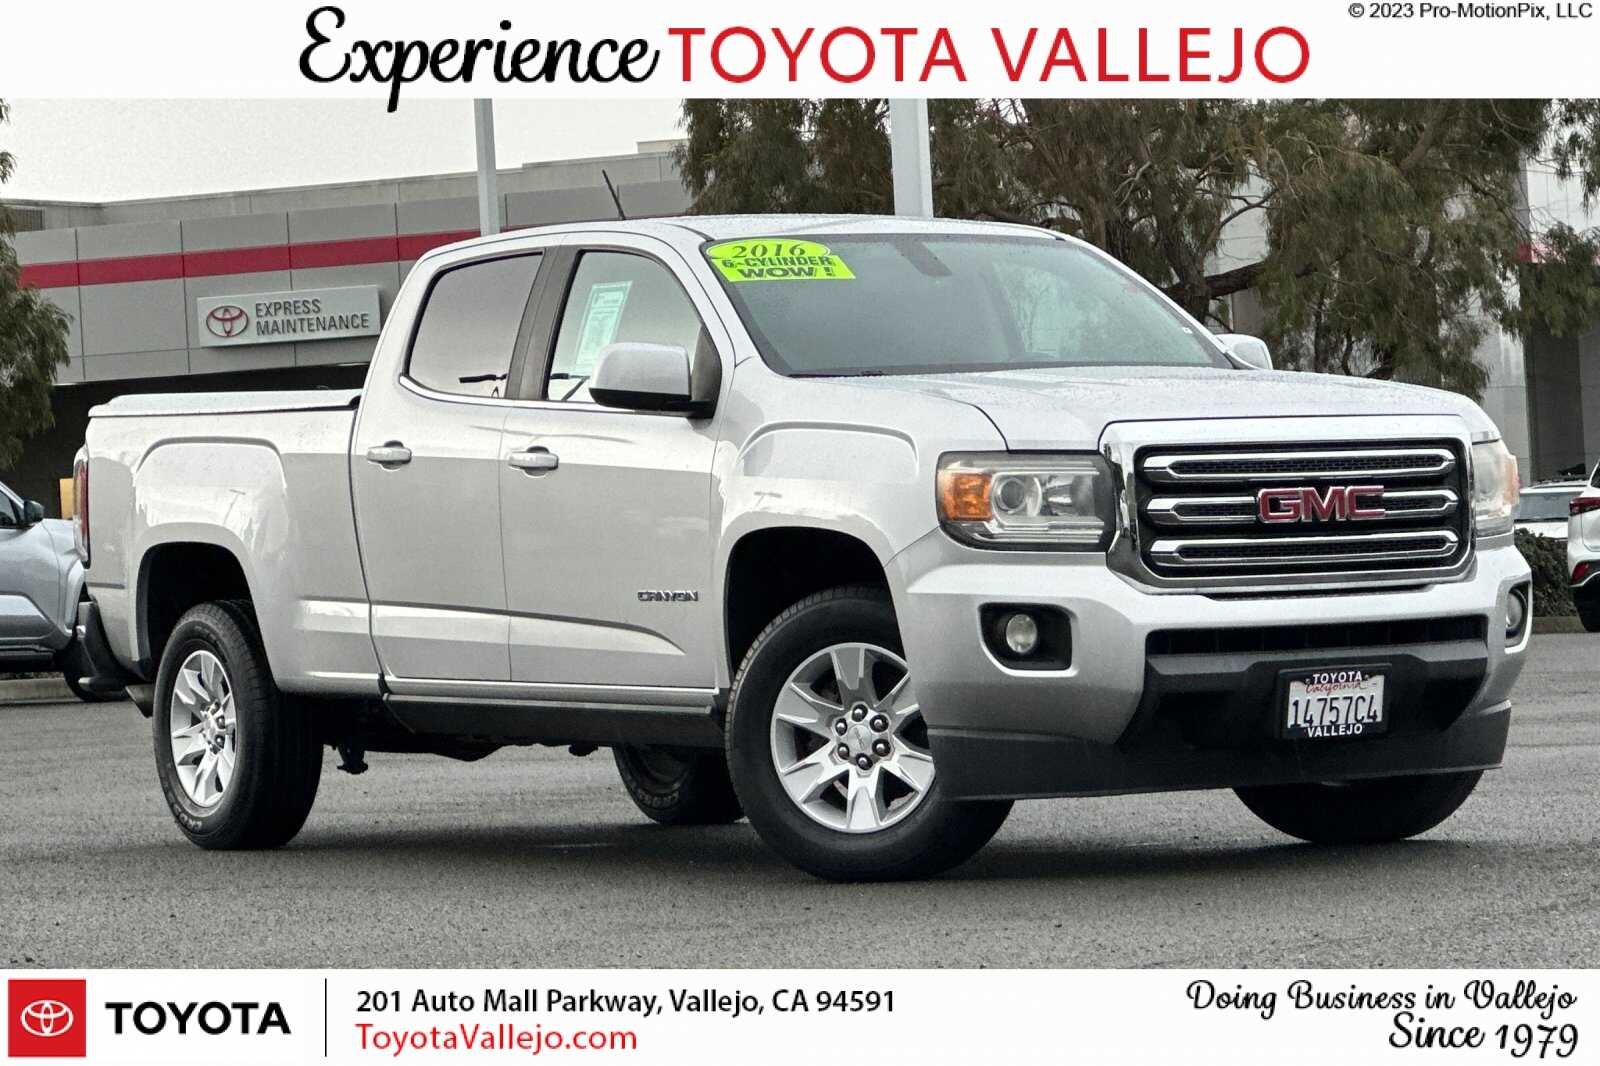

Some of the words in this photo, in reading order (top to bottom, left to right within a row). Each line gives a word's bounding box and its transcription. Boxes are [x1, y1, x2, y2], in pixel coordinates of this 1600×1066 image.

[732, 244, 806, 258] 2016
[255, 300, 321, 318] EXPRESS
[255, 313, 369, 337] MAINTENANCE
[1257, 485, 1386, 523] GMC
[637, 590, 699, 602] CANYON
[1312, 671, 1363, 684] TOYOTA
[1292, 694, 1378, 727] 14757C4
[1307, 723, 1363, 738] VALLEJO
